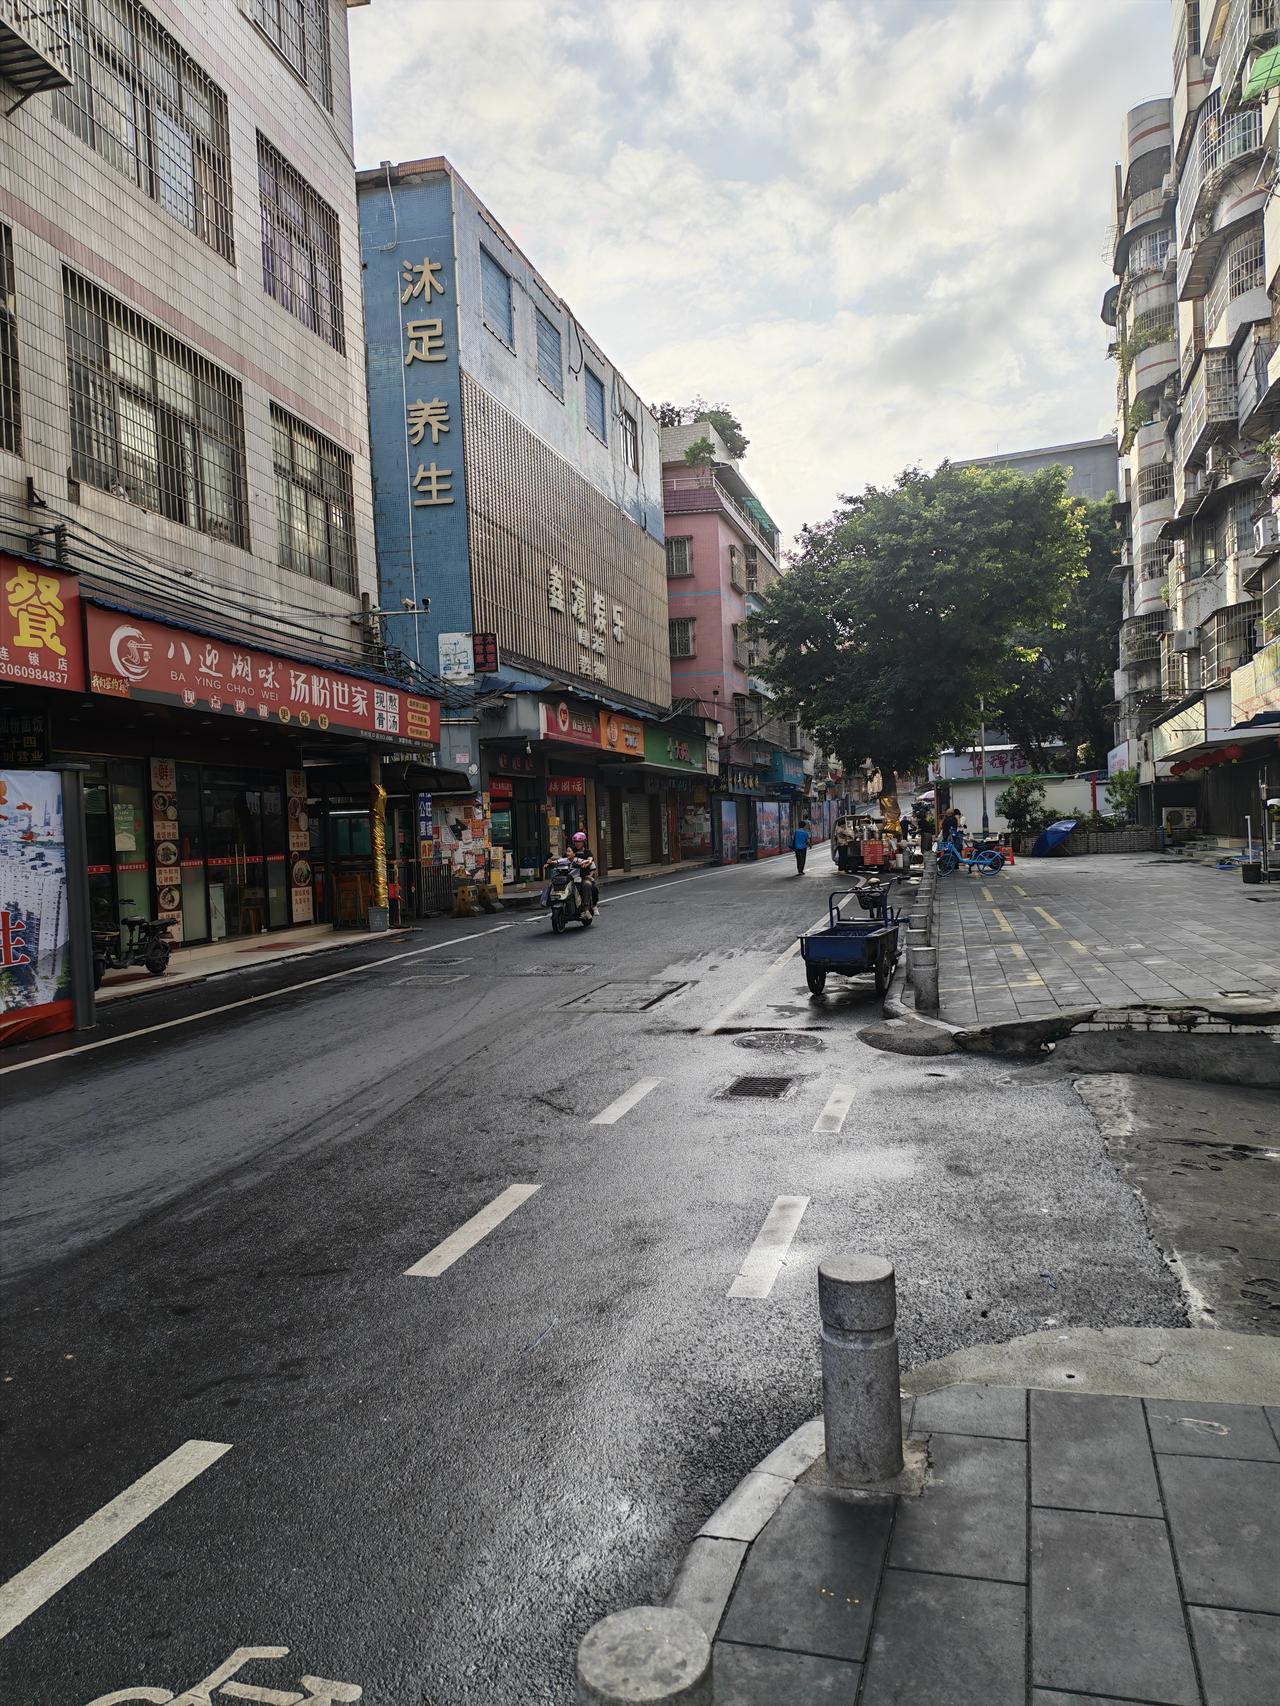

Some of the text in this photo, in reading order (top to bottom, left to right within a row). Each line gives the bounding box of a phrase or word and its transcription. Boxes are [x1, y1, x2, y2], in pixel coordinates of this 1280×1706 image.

[401, 256, 455, 507] 沐足养生
[5, 565, 67, 656] 餐
[0, 646, 68, 671] 连锁店
[168, 641, 280, 689] 八迎潮味
[170, 671, 279, 702] BA YING CHAO WEI
[289, 669, 368, 717] 汤粉世家
